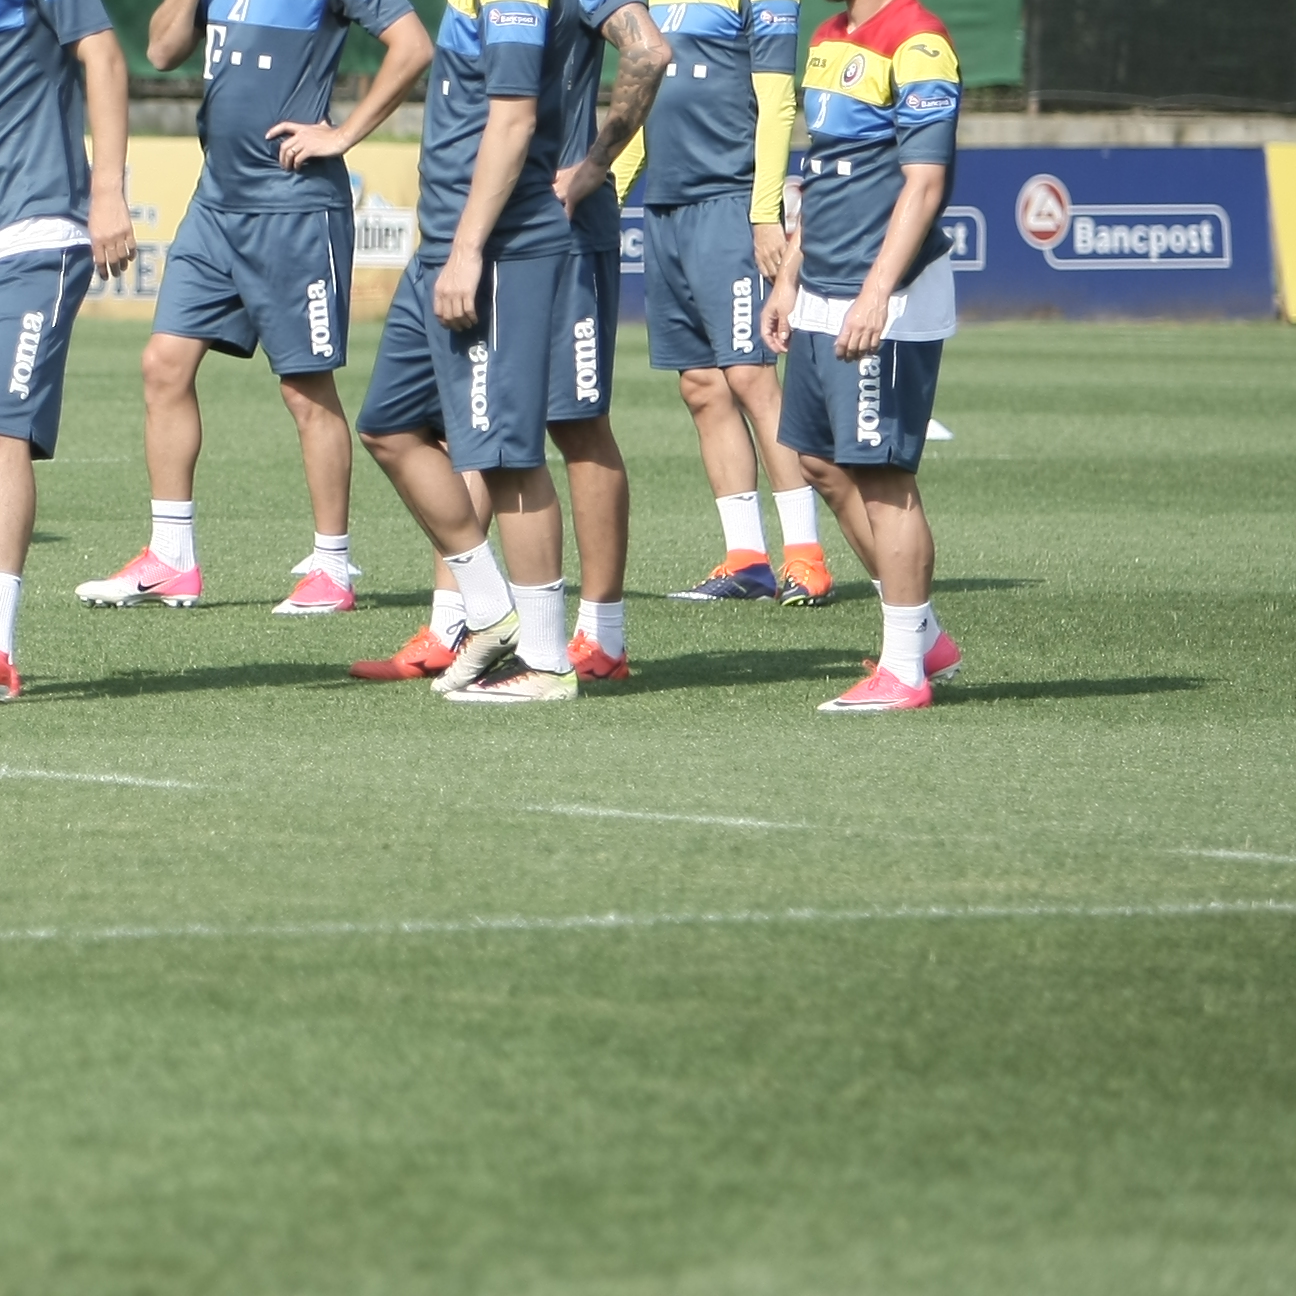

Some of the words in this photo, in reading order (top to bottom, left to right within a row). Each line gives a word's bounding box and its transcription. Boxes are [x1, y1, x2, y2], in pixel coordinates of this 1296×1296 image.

[660, 3, 687, 33] 20
[1073, 215, 1213, 262] Bancpost
[10, 310, 44, 400] Joma
[308, 279, 332, 358] Joma
[732, 278, 754, 354] Joma
[469, 340, 491, 432] Joma
[574, 316, 601, 404] Joma
